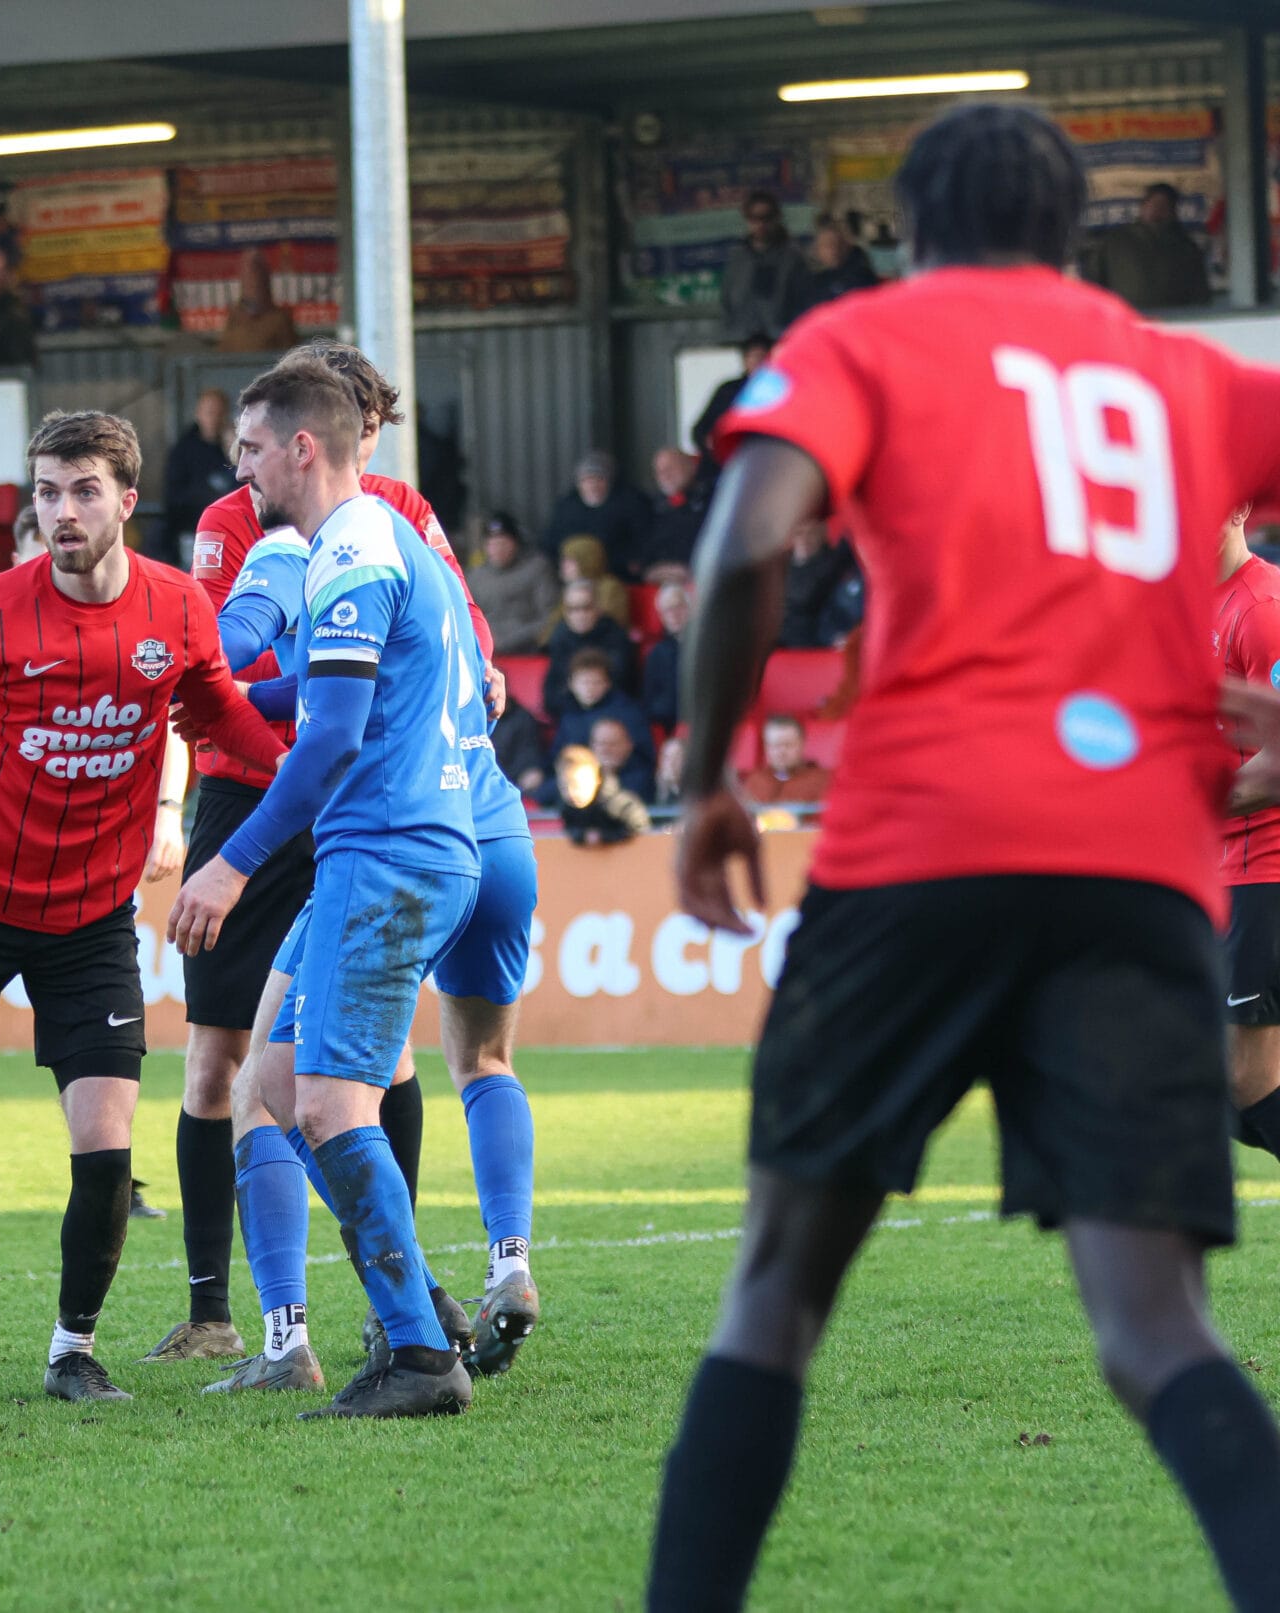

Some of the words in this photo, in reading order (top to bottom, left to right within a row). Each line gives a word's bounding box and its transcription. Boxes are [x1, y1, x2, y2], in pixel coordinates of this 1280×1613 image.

[991, 345, 1179, 582] 19
[138, 661, 166, 670] LEWES
[52, 694, 142, 728] who
[18, 727, 134, 761] gives
[45, 751, 135, 779] crap
[559, 911, 640, 997] a
[501, 1239, 526, 1259] FS
[290, 1304, 307, 1323] F
